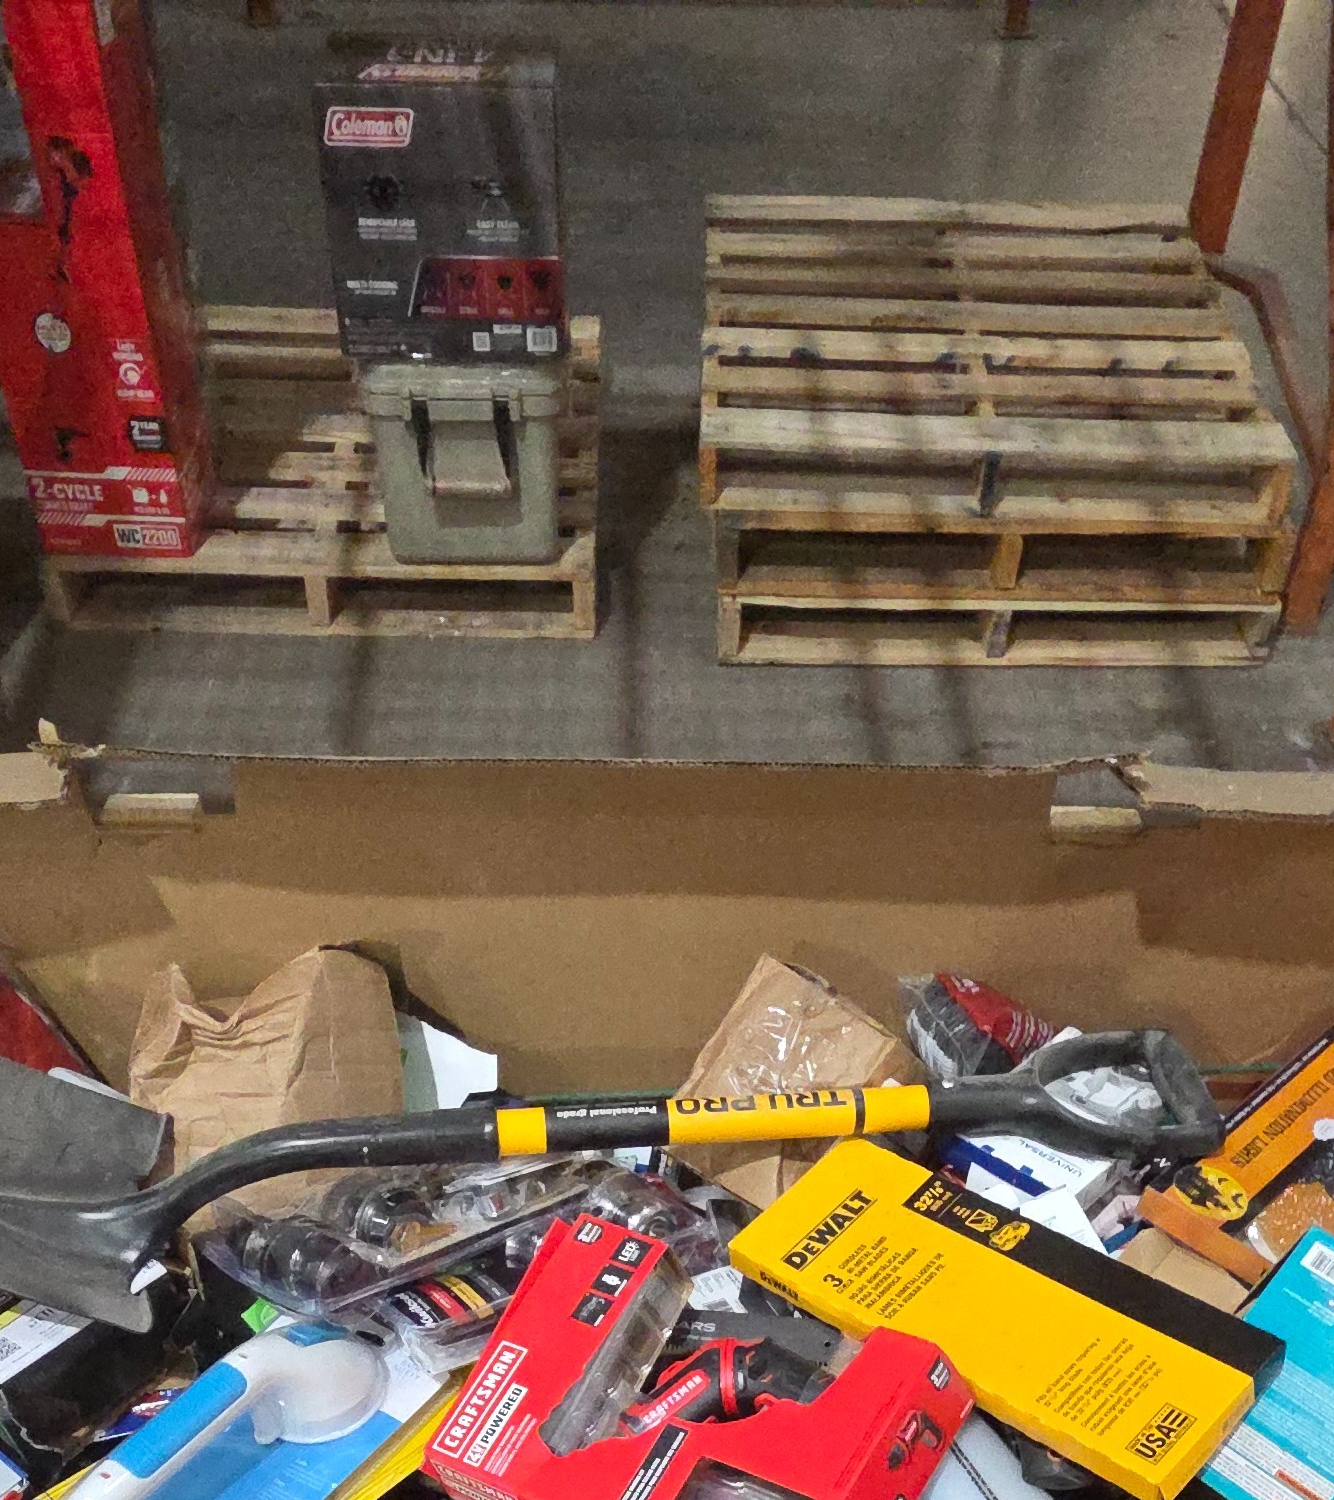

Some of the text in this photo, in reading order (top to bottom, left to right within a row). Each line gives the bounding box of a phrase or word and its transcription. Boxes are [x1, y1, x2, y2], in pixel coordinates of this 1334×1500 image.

[331, 112, 392, 136] Coleman
[30, 477, 104, 502] 2-CYCLE
[117, 527, 179, 547] WC 2200
[588, 1104, 658, 1119] Professional
[675, 1090, 848, 1116] TRU PRO
[1019, 1138, 1083, 1178] UNIVERSAL
[783, 1189, 876, 1272] DEWALT
[760, 1270, 798, 1301] DEWALT
[823, 1273, 844, 1289] 3
[443, 1349, 517, 1449] CRAFTSMAN
[643, 1373, 703, 1425] CRAFTSMAN
[481, 1387, 524, 1446] POWERED
[1134, 1422, 1176, 1459] USA
